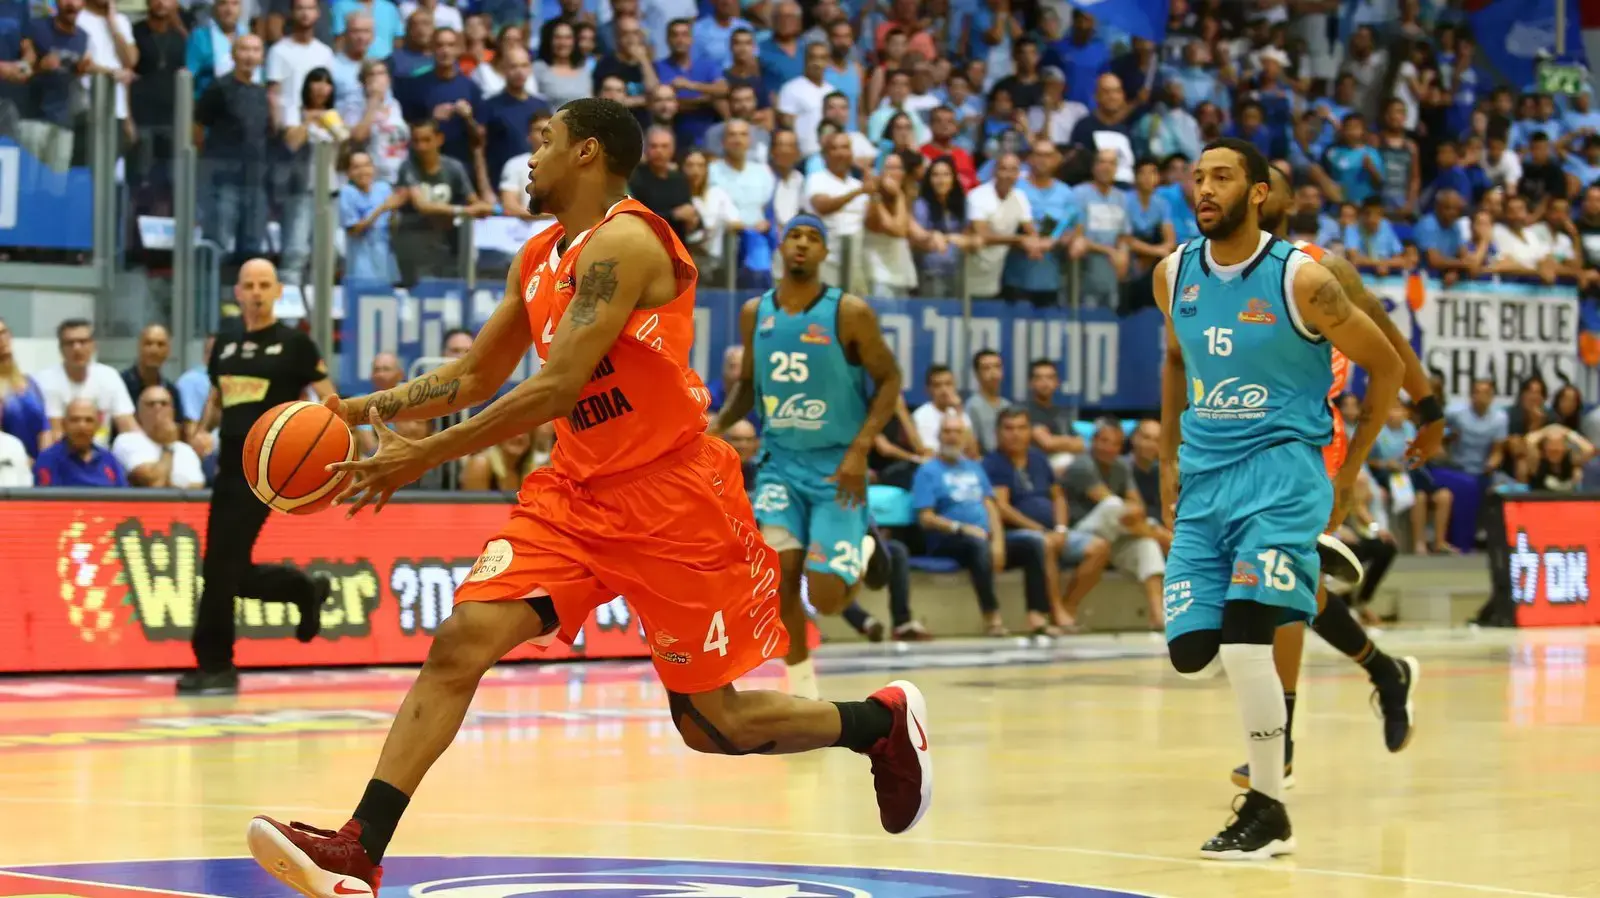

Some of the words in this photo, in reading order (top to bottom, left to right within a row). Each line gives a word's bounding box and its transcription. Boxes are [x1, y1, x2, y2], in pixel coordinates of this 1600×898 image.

[1203, 326, 1233, 357] 15
[1436, 298, 1490, 341] THE
[1500, 302, 1573, 344] BLUE
[769, 351, 809, 383] 25
[571, 387, 634, 434] MEDIA
[1257, 549, 1296, 591] 15
[703, 610, 729, 657] 4
